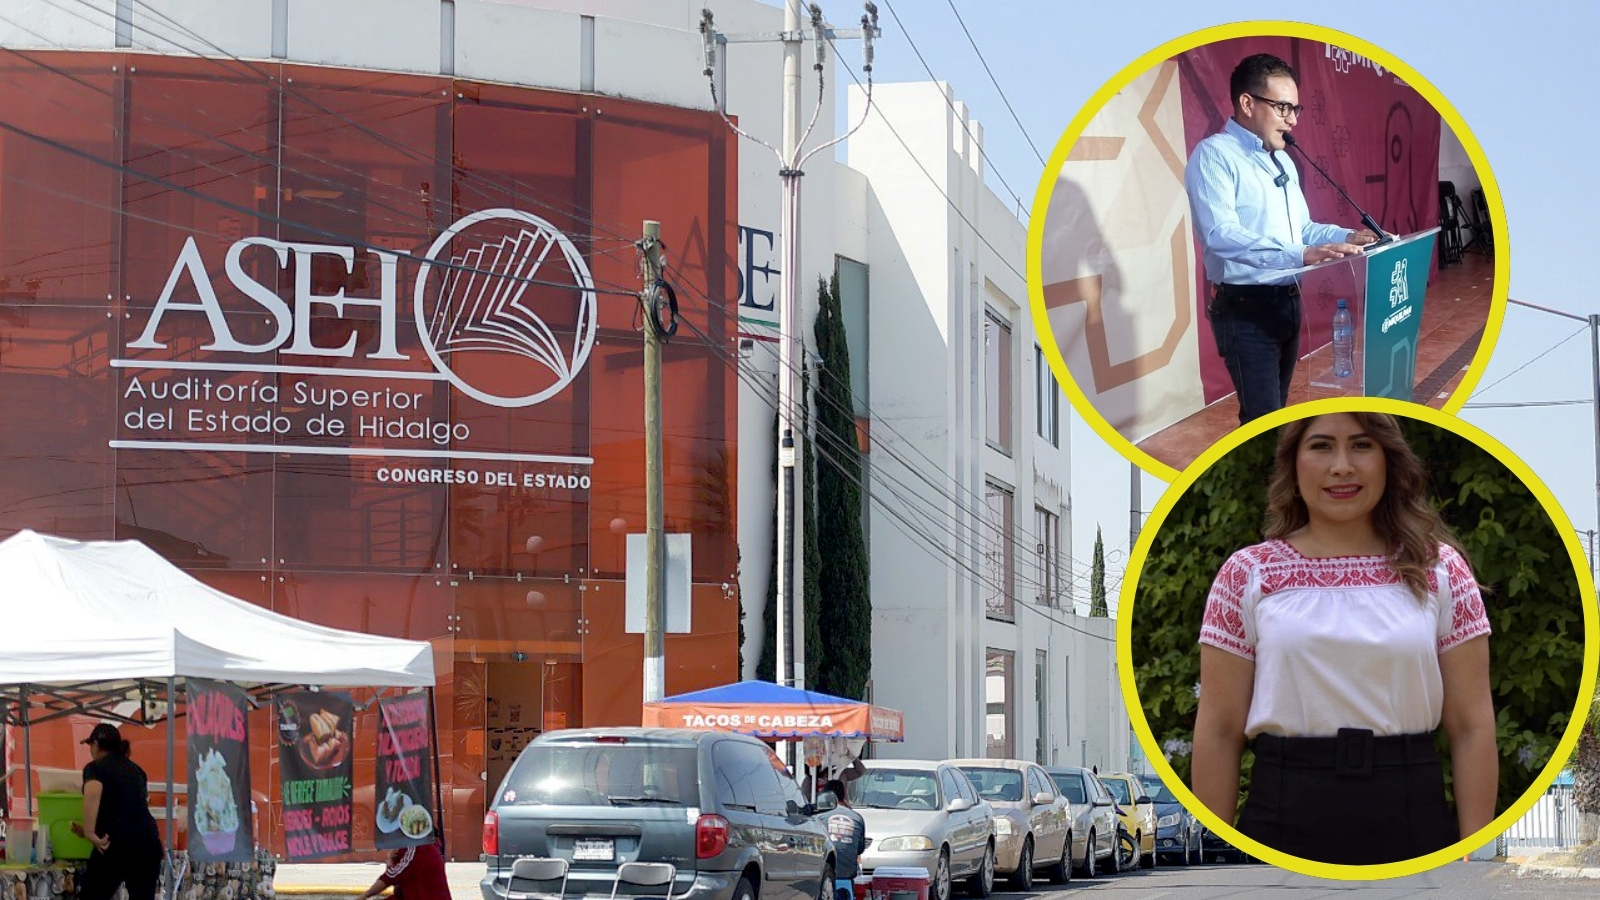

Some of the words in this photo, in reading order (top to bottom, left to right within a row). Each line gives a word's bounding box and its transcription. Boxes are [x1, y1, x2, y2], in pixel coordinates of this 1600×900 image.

[123, 376, 278, 403] Auditoría
[293, 381, 423, 411] Superior
[124, 406, 173, 430] del
[188, 409, 291, 434] Estado
[306, 412, 345, 436] de
[359, 415, 470, 445] Hidalgo
[376, 467, 479, 484] CONGRESO
[485, 471, 518, 487] DEL
[523, 473, 592, 489] ESTADO
[683, 714, 742, 727] TACOS
[744, 715, 756, 724] DE
[758, 714, 833, 727] CABEZA
[322, 805, 349, 827] ROJOS
